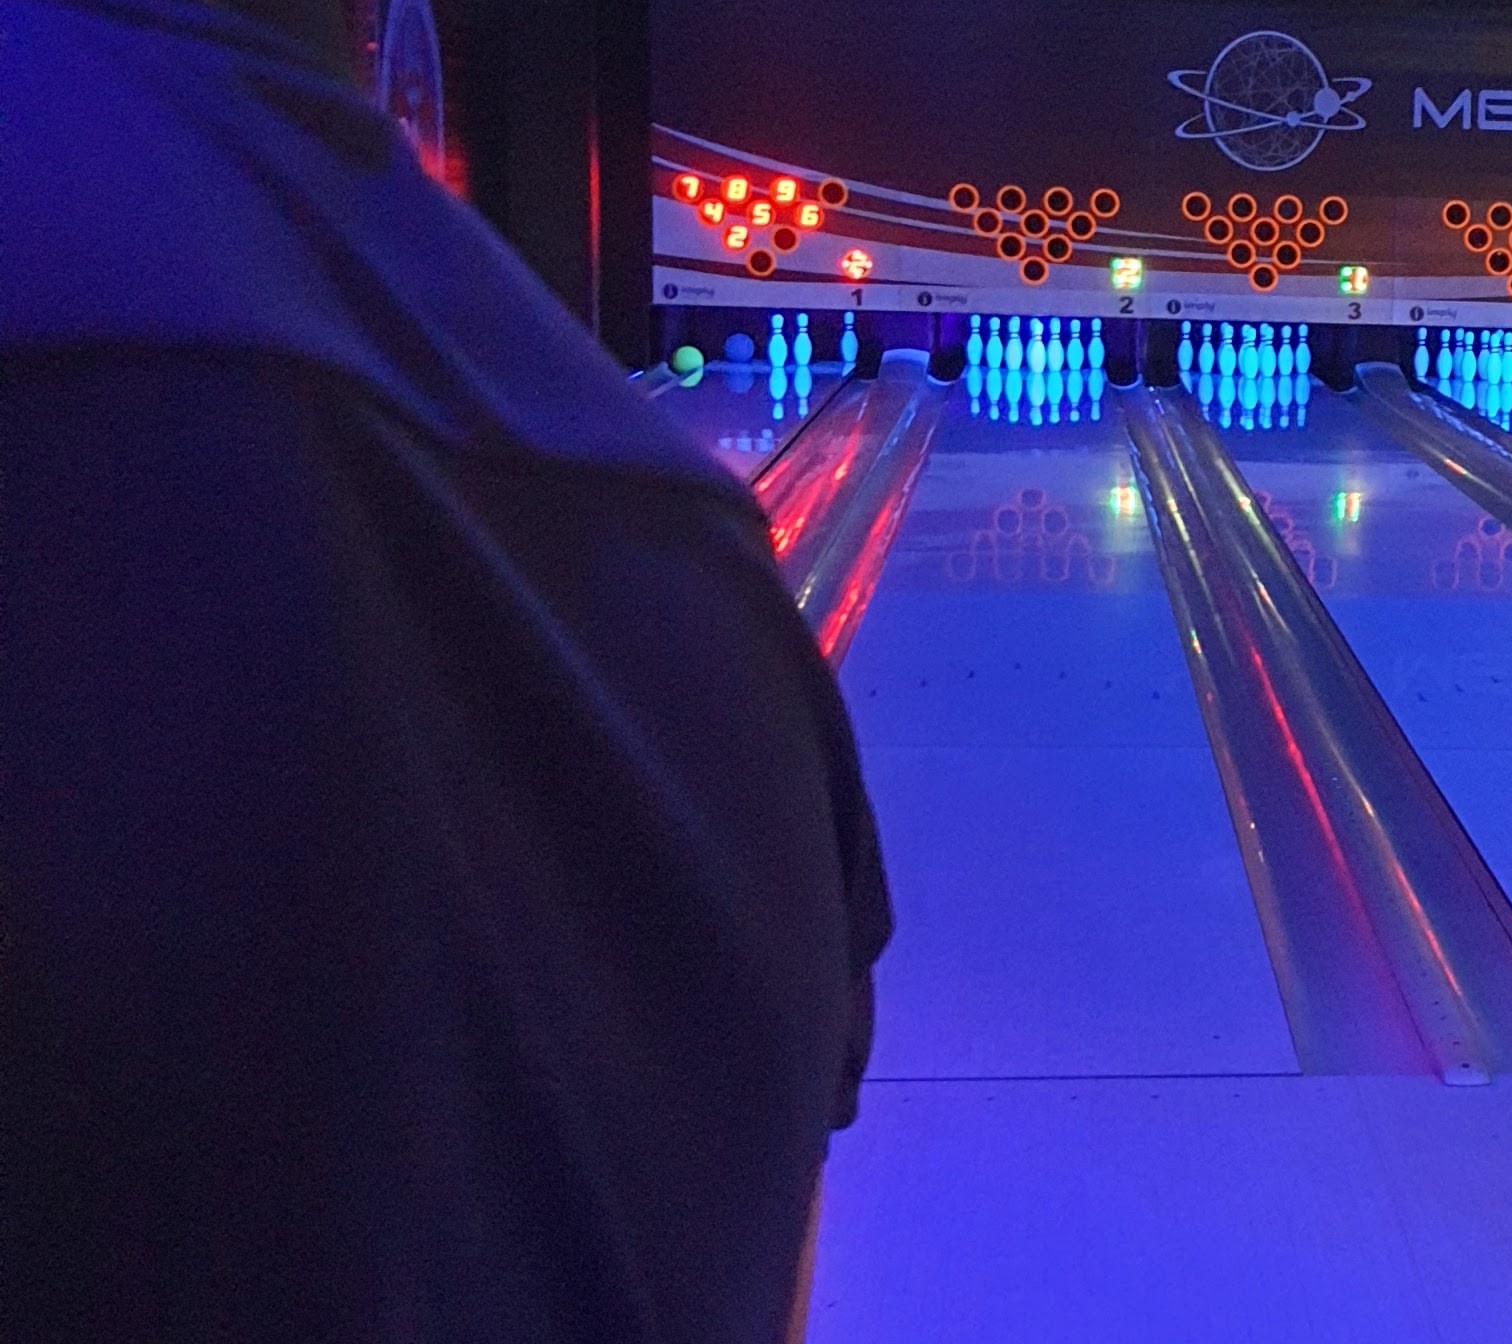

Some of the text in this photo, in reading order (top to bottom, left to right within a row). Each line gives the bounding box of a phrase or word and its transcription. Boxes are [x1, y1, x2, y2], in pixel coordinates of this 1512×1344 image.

[682, 176, 797, 202] 7 8 9
[704, 202, 819, 226] 4 5 6
[727, 225, 748, 248] 2
[851, 288, 863, 306] 1
[1119, 296, 1135, 314] 2
[1348, 302, 1362, 320] 3
